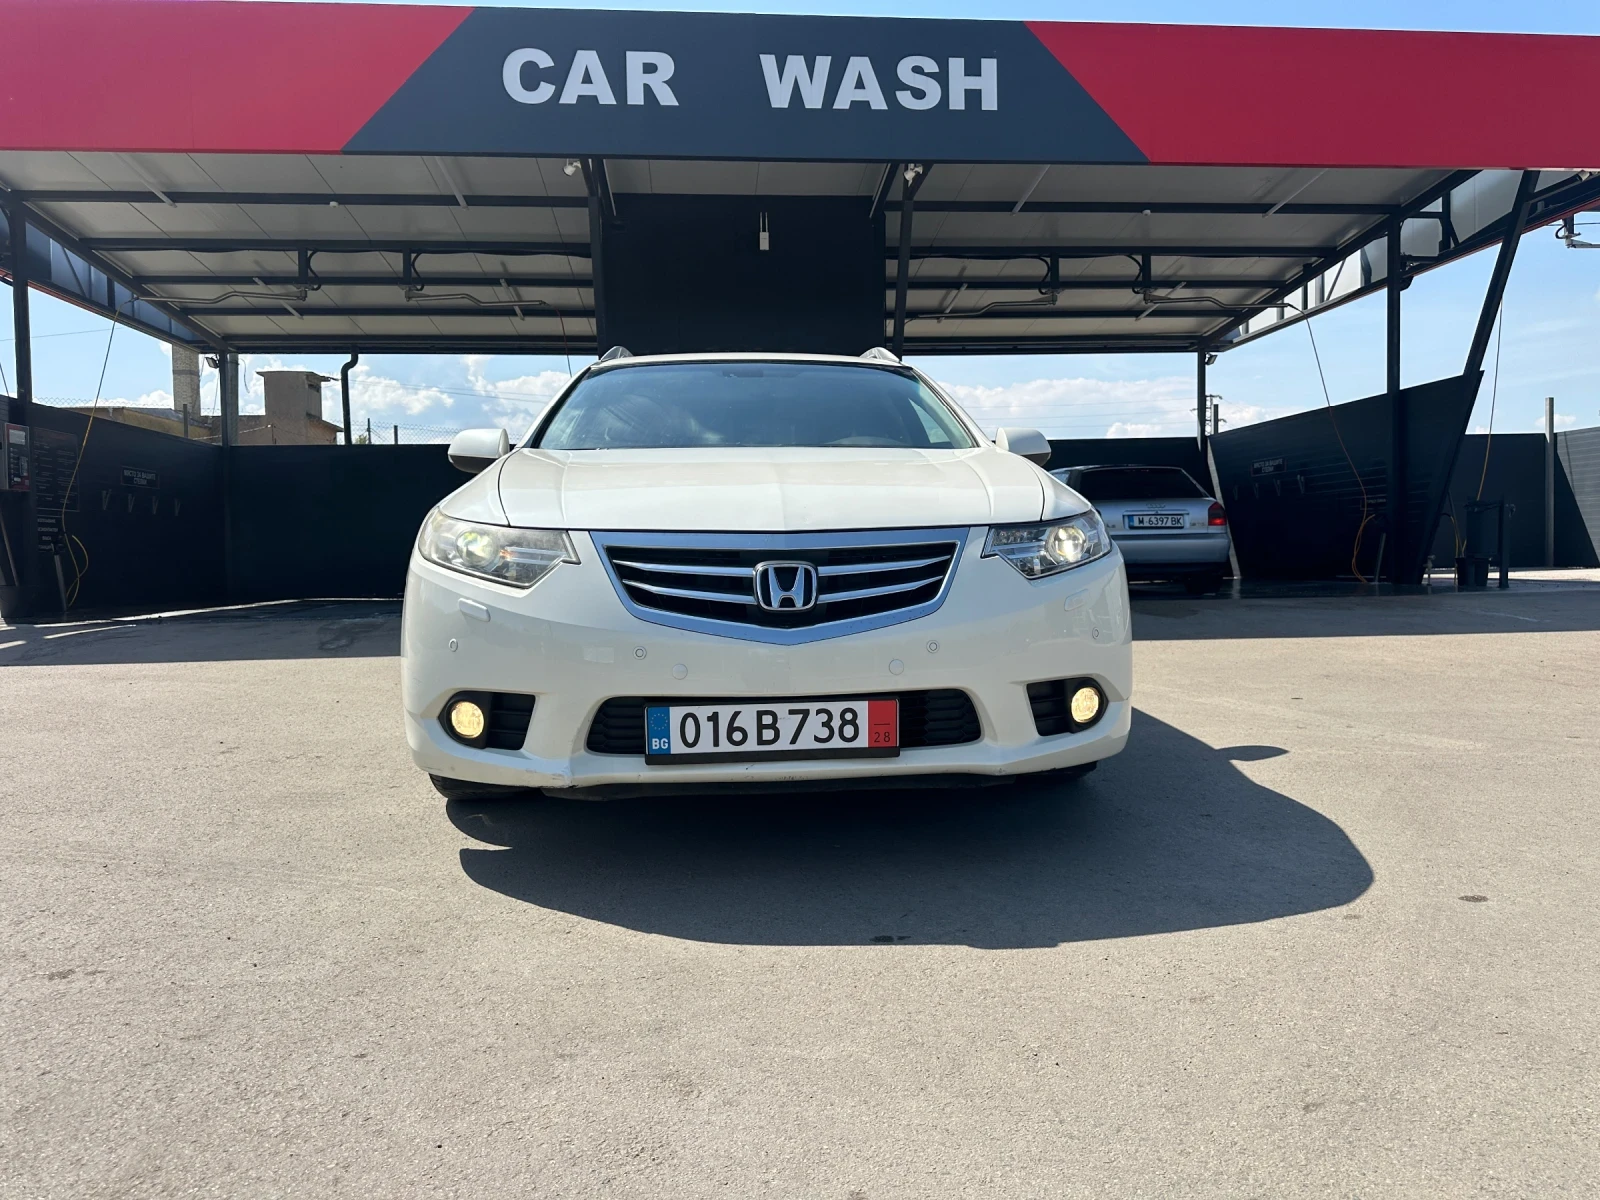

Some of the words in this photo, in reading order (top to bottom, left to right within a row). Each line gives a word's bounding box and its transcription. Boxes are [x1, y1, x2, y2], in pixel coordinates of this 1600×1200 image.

[502, 47, 679, 106] CAR
[760, 54, 999, 111] WASH
[1148, 516, 1169, 526] 6397
[1171, 516, 1183, 526] BK
[679, 707, 860, 749] 016B738
[874, 731, 891, 743] 28
[652, 738, 669, 750] BG
